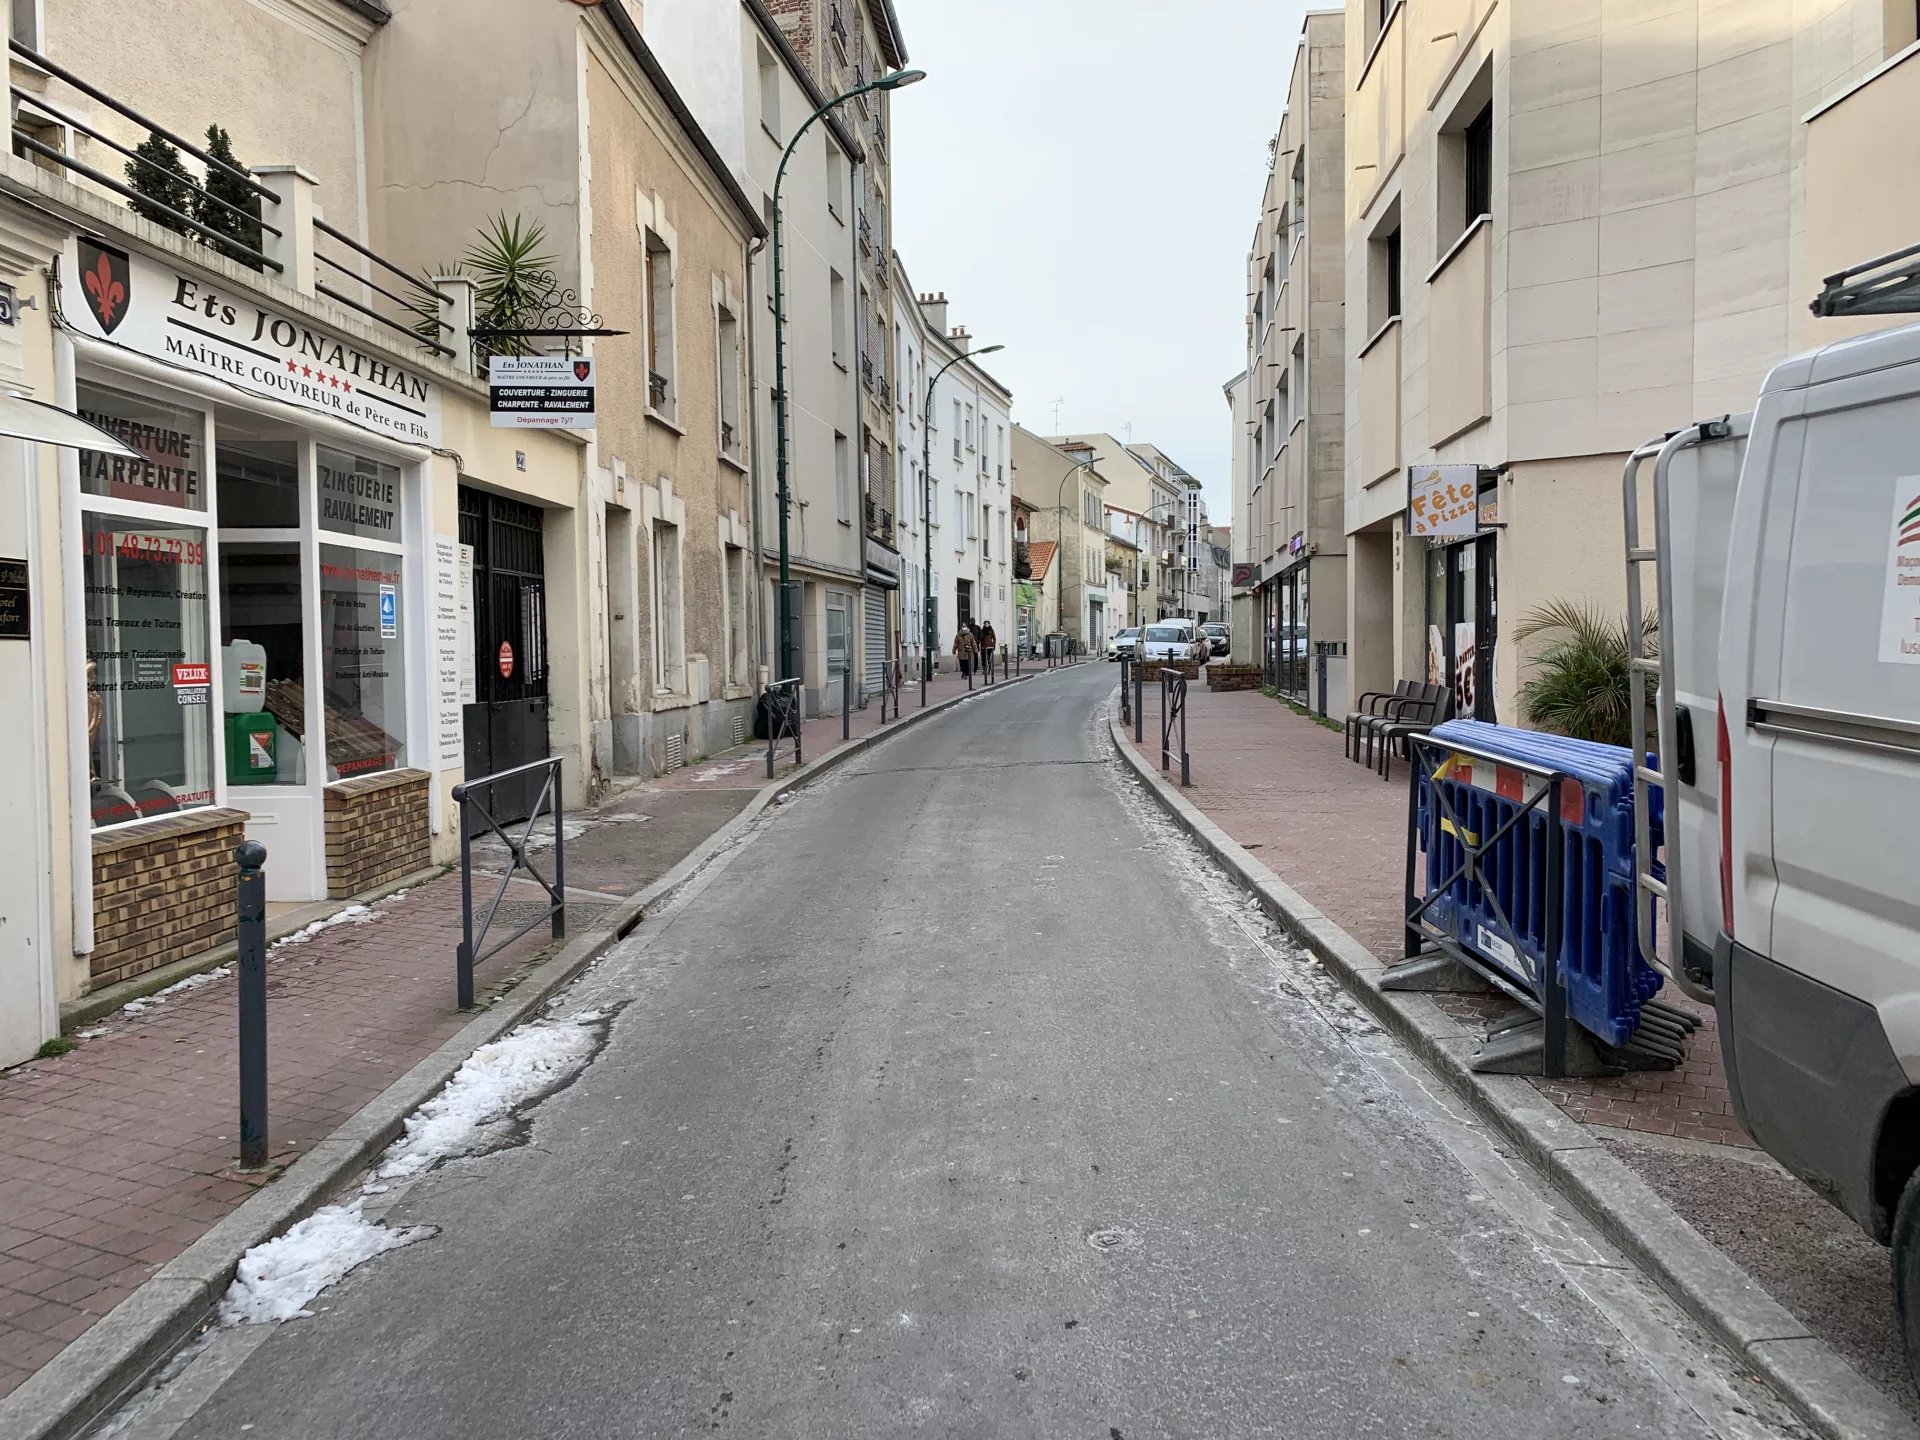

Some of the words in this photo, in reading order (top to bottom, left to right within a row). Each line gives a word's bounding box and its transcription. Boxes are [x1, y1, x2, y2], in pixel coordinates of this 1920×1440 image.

[171, 274, 236, 326] Ets
[251, 309, 430, 404] JONATHAN
[516, 361, 564, 369] JONATHAN
[165, 335, 245, 377] MAÎTRE
[251, 366, 342, 410] COUVREUR
[346, 400, 361, 417] de
[365, 406, 390, 427] Père
[394, 421, 407, 432] en
[410, 422, 429, 440] Fils
[499, 388, 546, 397] COUVERTURE
[551, 389, 588, 397] ZINGUERIE
[498, 400, 539, 409] CHARPENTE
[544, 401, 590, 409] RAVALEMENT
[517, 416, 559, 425] Dépannage
[80, 449, 197, 495] HARPENTE
[323, 469, 393, 504] ZINGUERIE
[1411, 483, 1474, 517] Fête
[324, 497, 394, 530] RAVALEMENT
[1416, 521, 1426, 533] à
[1428, 501, 1476, 528] Pizza
[106, 616, 139, 628] Travaux
[142, 618, 152, 628] de
[155, 618, 182, 629] Toiture
[176, 668, 206, 681] VELUX
[177, 694, 207, 704] CONSEIL
[176, 789, 213, 805] GRATUITS
